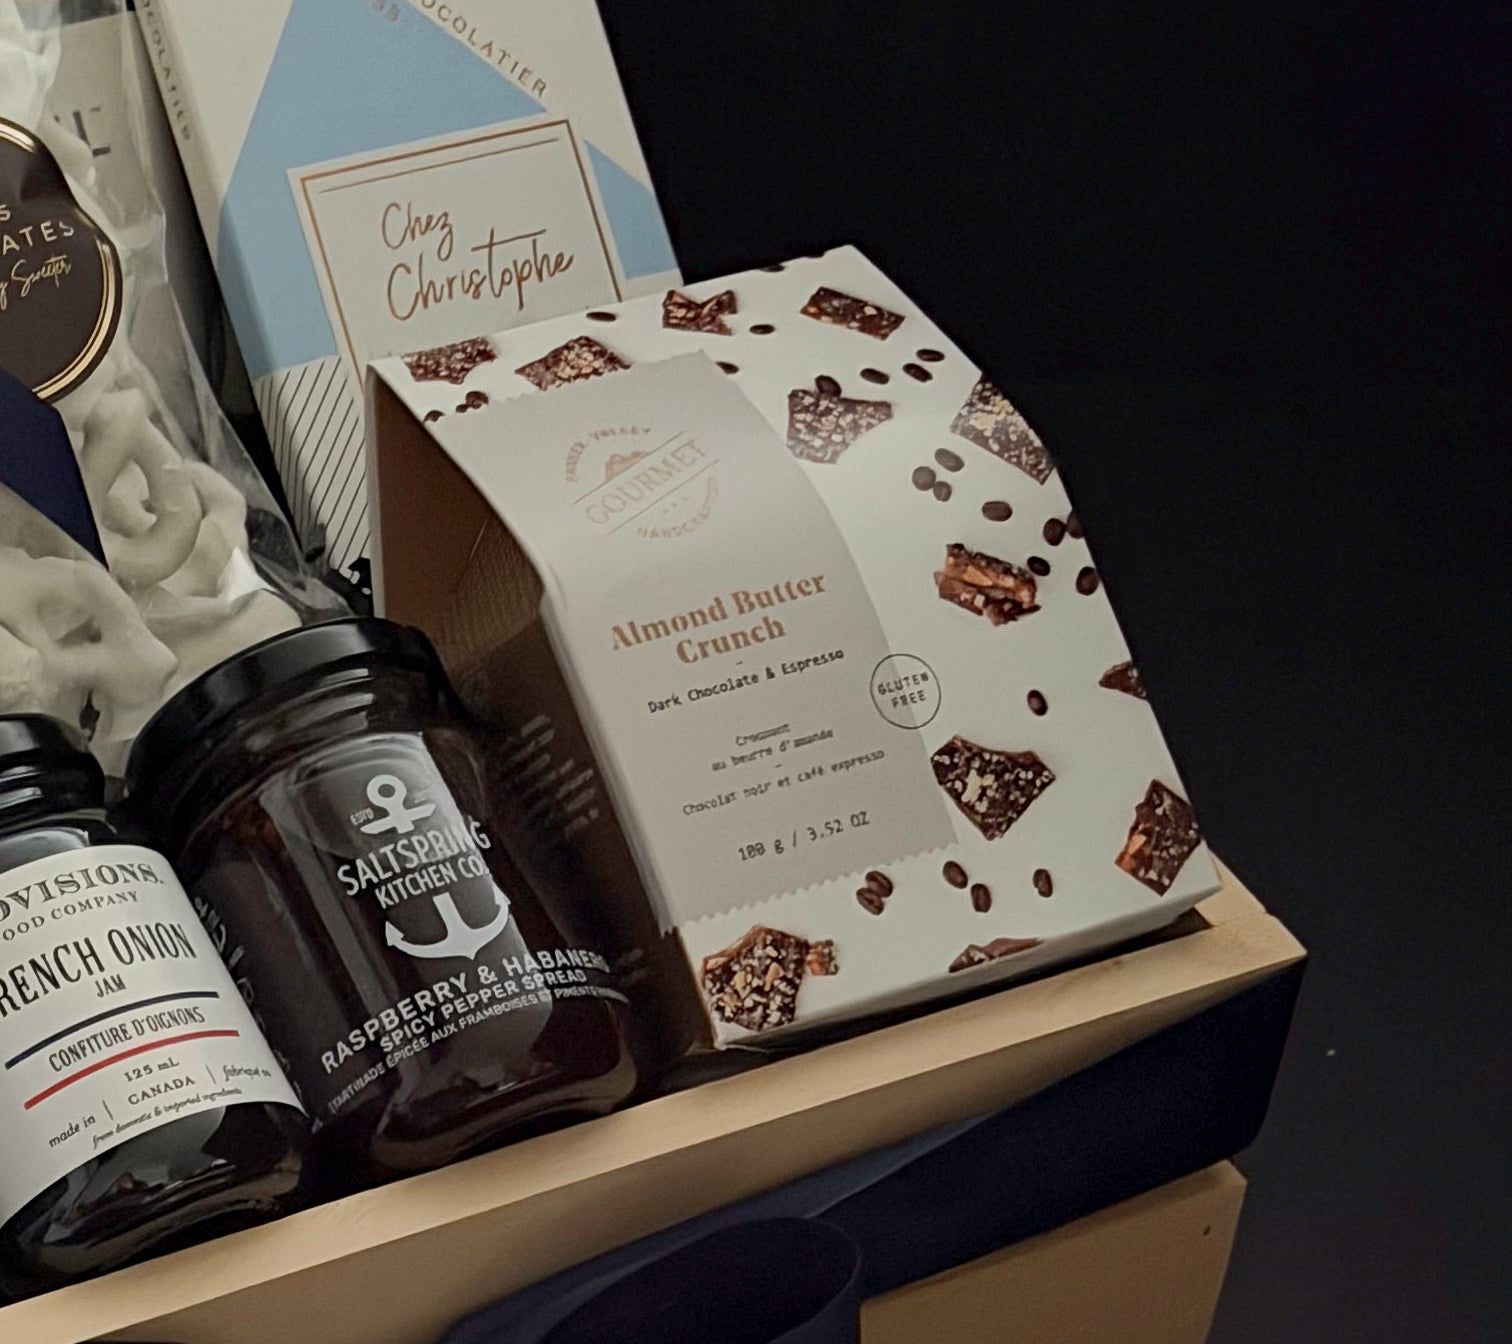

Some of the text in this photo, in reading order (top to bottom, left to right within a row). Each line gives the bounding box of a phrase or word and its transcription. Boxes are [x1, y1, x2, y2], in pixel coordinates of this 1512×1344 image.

[381, 202, 454, 261] Chez
[387, 228, 574, 321] Christophe
[585, 440, 705, 524] GOURMET
[611, 575, 825, 651] Almond Butter
[676, 615, 786, 664] Crunch
[648, 650, 844, 713] Dark Chocolate & Espresso
[878, 672, 929, 695] GLUTEN
[891, 690, 926, 709] FREE
[683, 750, 885, 815] Chocolat noir et café expresso
[337, 816, 491, 895] SALTSPRING
[807, 819, 844, 841] 3.52
[51, 890, 139, 920] COMPANY
[375, 862, 458, 910] KITCHEN
[107, 921, 197, 965] ONION
[95, 974, 127, 998] JAM
[380, 969, 587, 1053] SPICY PEPPER SPREAD
[48, 1005, 206, 1073] CONFITURE D'OIGNONS
[321, 972, 468, 1074] RASPBERRY
[478, 965, 497, 985] &
[431, 1022, 458, 1048] AUX
[459, 994, 537, 1030] FRAMBOISES
[123, 1064, 153, 1083] 125
[48, 1120, 80, 1148] made
[84, 1114, 96, 1128] in
[127, 1076, 196, 1106] CANADA
